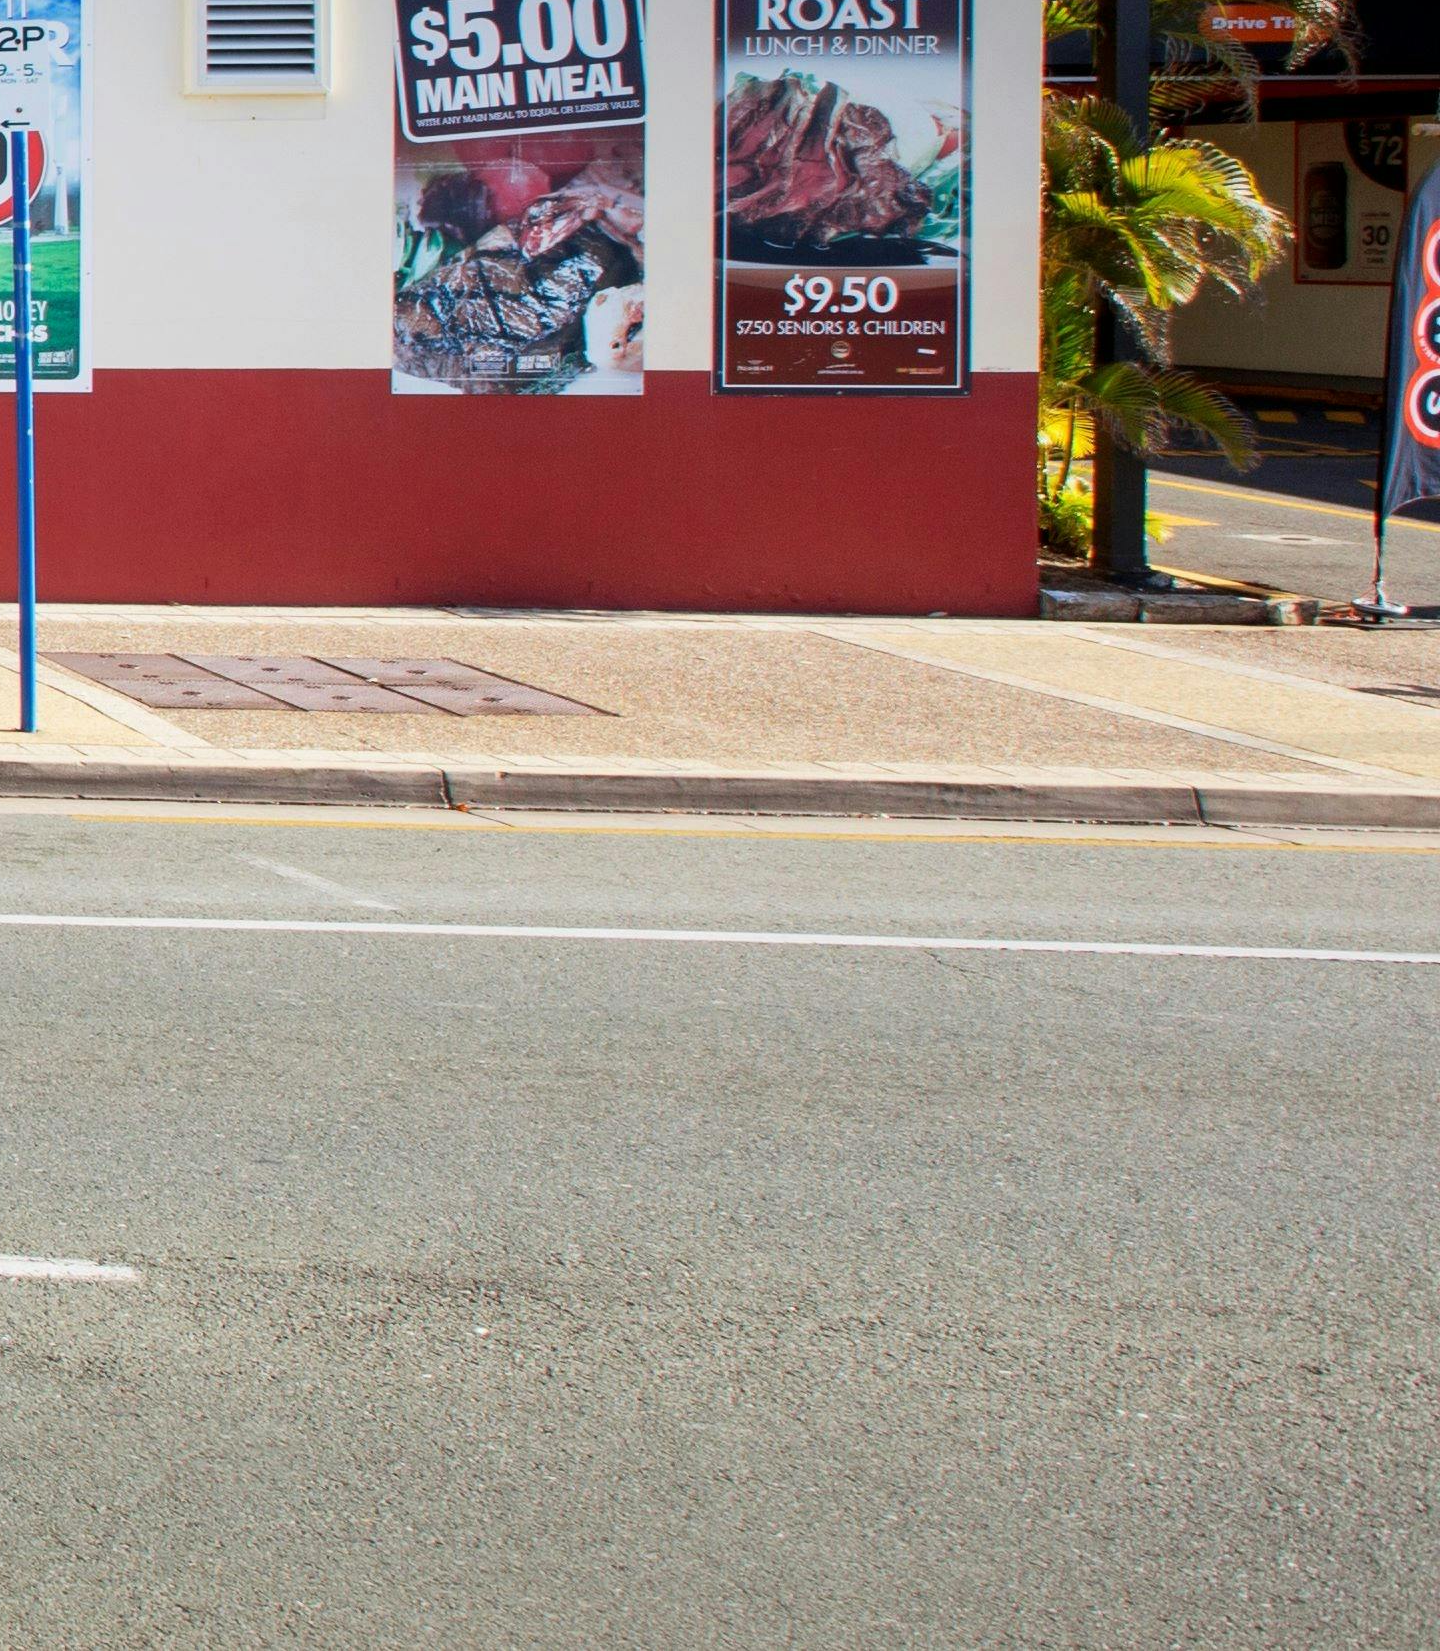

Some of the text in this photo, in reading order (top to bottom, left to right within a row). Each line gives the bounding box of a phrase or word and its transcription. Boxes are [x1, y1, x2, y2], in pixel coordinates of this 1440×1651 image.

[1211, 17, 1267, 29] Drive
[745, 35, 940, 57] LUNCH & DINNER
[416, 62, 634, 113] MAIN MEAL
[416, 100, 640, 128] WITH ANY MAIN MEAL TO EQUAL OR LESSER VALUE
[1362, 225, 1389, 245] 30
[784, 273, 898, 317] $9.50
[777, 321, 843, 335] SENIORS
[846, 321, 861, 335] &
[863, 320, 946, 335] CHILDREN
